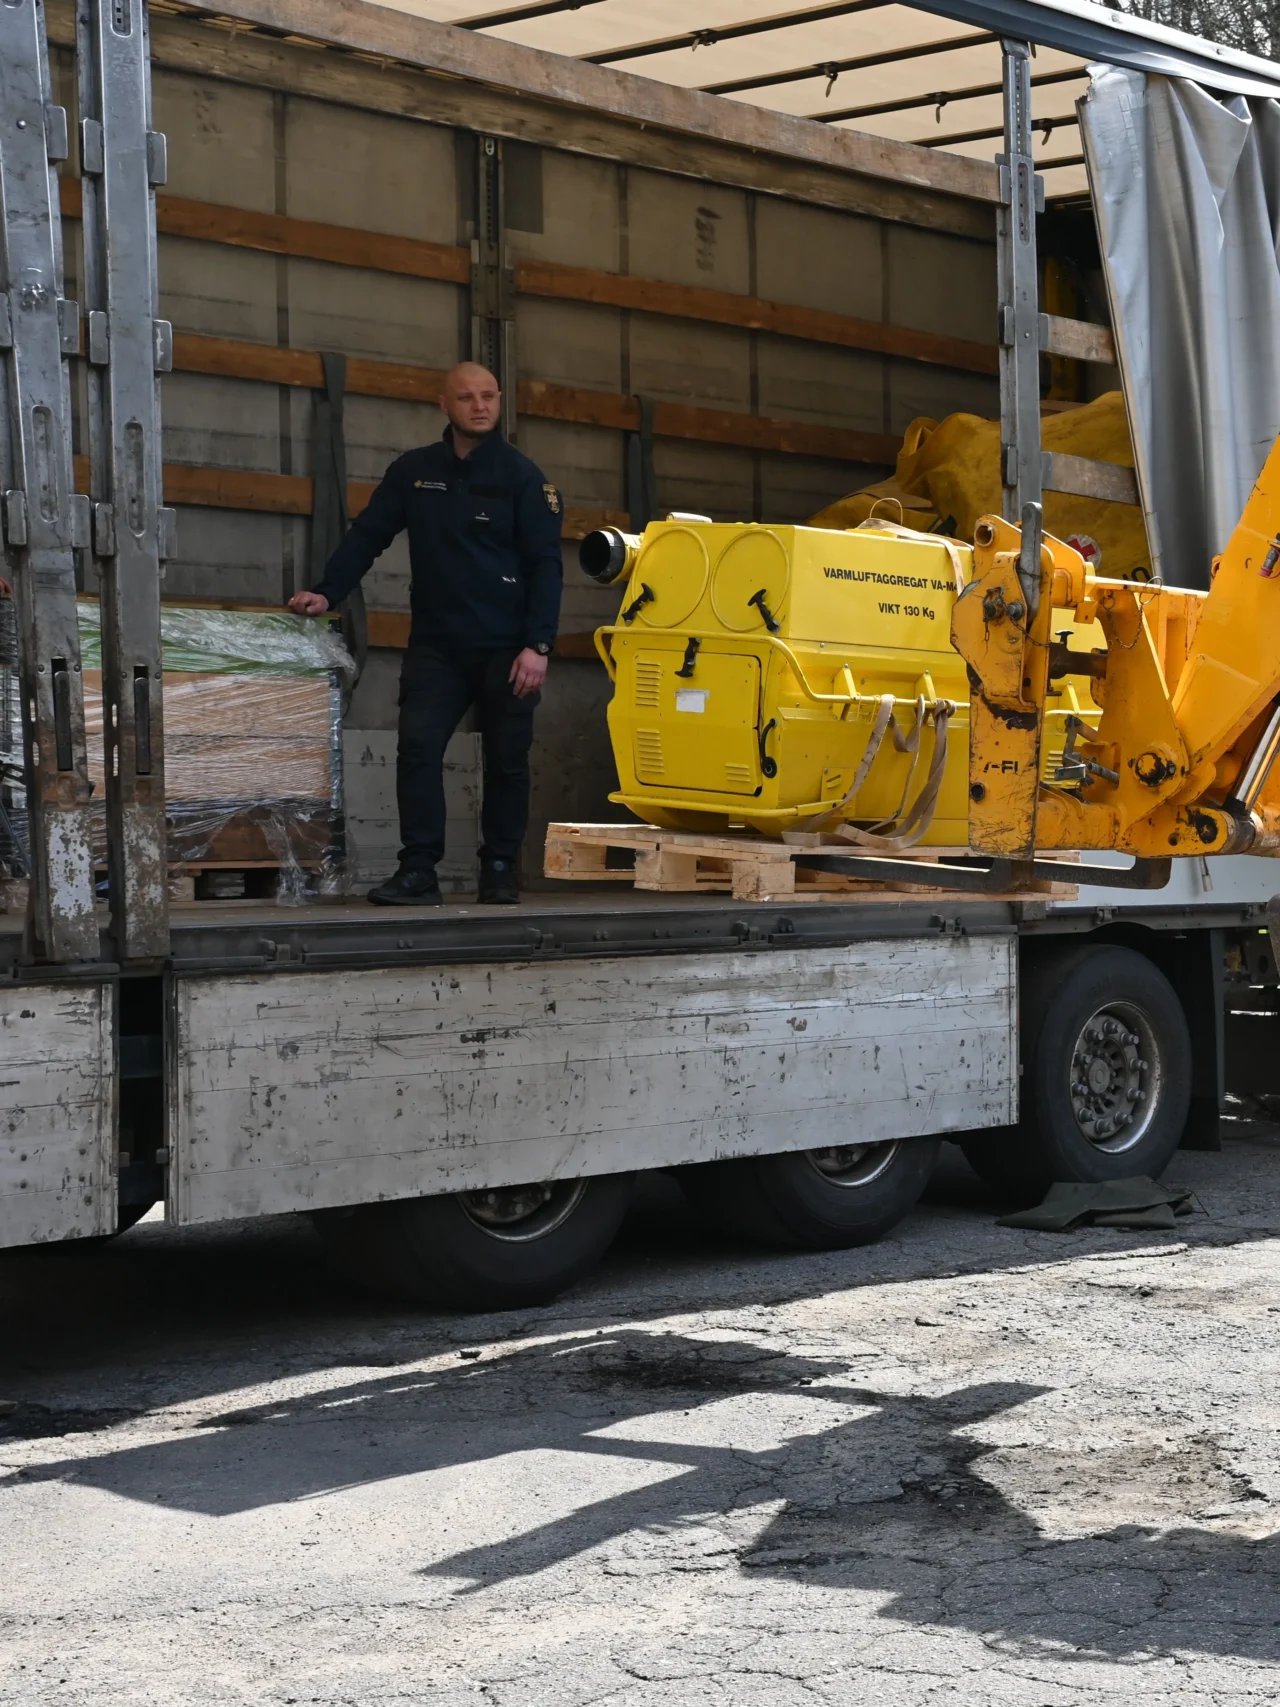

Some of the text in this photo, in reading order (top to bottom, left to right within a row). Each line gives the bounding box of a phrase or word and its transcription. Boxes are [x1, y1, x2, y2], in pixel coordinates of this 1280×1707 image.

[823, 567, 928, 589] VARMLUFTAGGREGAT
[878, 602, 935, 620] VIKT 130 Kg
